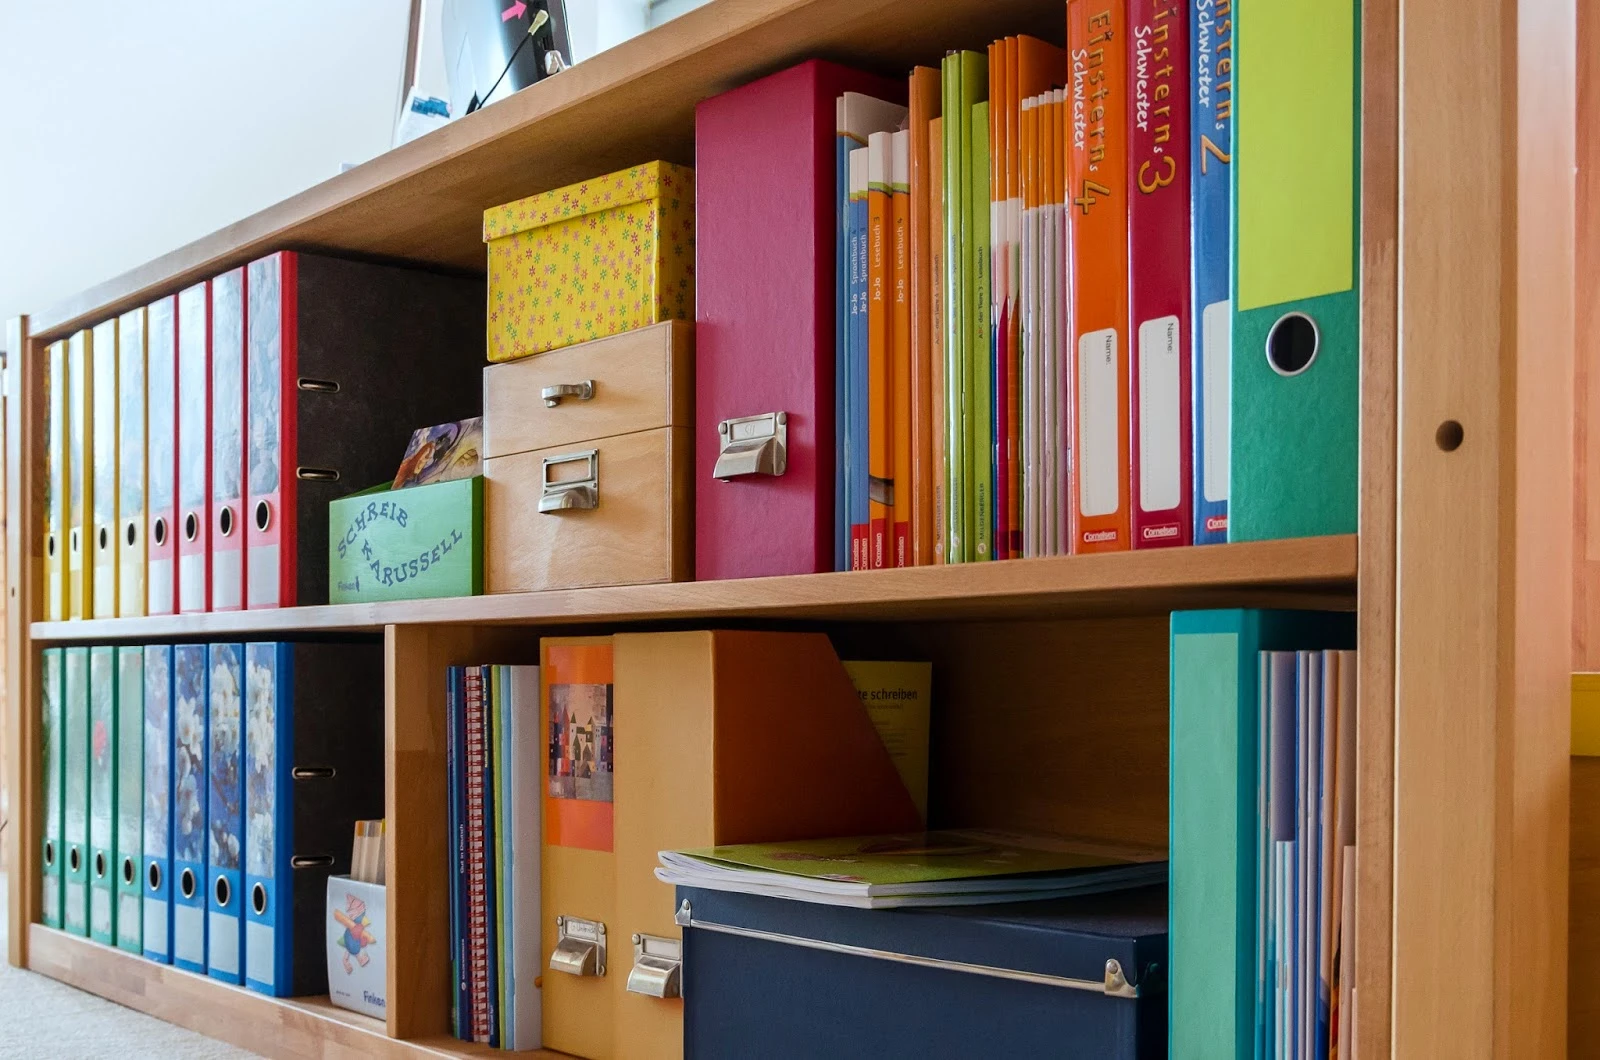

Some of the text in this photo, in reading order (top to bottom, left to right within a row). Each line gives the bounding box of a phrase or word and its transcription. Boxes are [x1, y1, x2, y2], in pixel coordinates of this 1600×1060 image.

[1196, 0, 1215, 109] Schwester
[1071, 48, 1089, 151] Schwester
[1088, 9, 1115, 172] Einsterns
[1133, 24, 1153, 132] Schwester
[1137, 155, 1177, 195] 3
[1200, 133, 1231, 176] 2
[1073, 179, 1111, 215] 4
[851, 236, 859, 285] Sprachbuch
[859, 234, 868, 283] Sprachbuch
[873, 224, 881, 268] Lesebuch
[896, 226, 904, 270] Lesebuch
[859, 291, 867, 313] Jo-Jo
[873, 277, 881, 301] Jo-Jo
[896, 279, 904, 303] Jo-Jo
[1105, 334, 1113, 366] Name:
[337, 501, 408, 559] SCHREIB
[361, 528, 463, 588] KARUSSELL
[870, 688, 918, 700] schreiben
